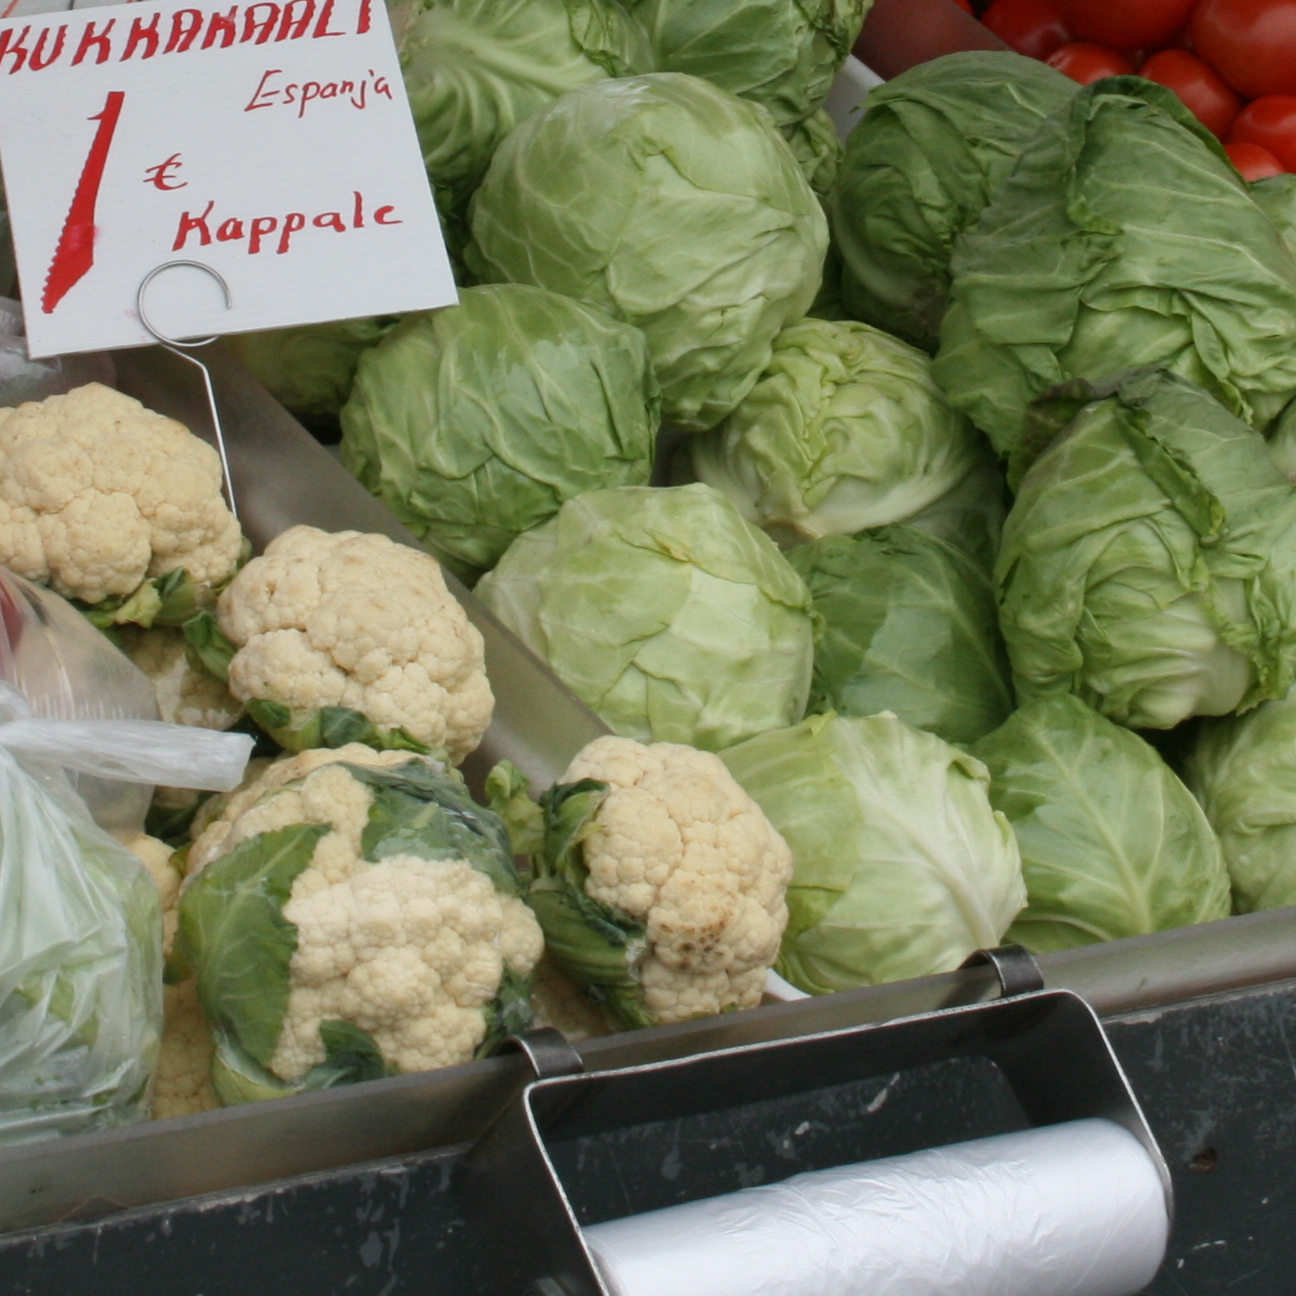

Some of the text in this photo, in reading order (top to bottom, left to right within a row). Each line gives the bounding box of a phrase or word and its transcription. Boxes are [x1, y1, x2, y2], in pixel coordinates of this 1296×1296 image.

[244, 68, 393, 118] Espanja
[39, 90, 189, 315] 1 €
[171, 190, 403, 255] Kappale
